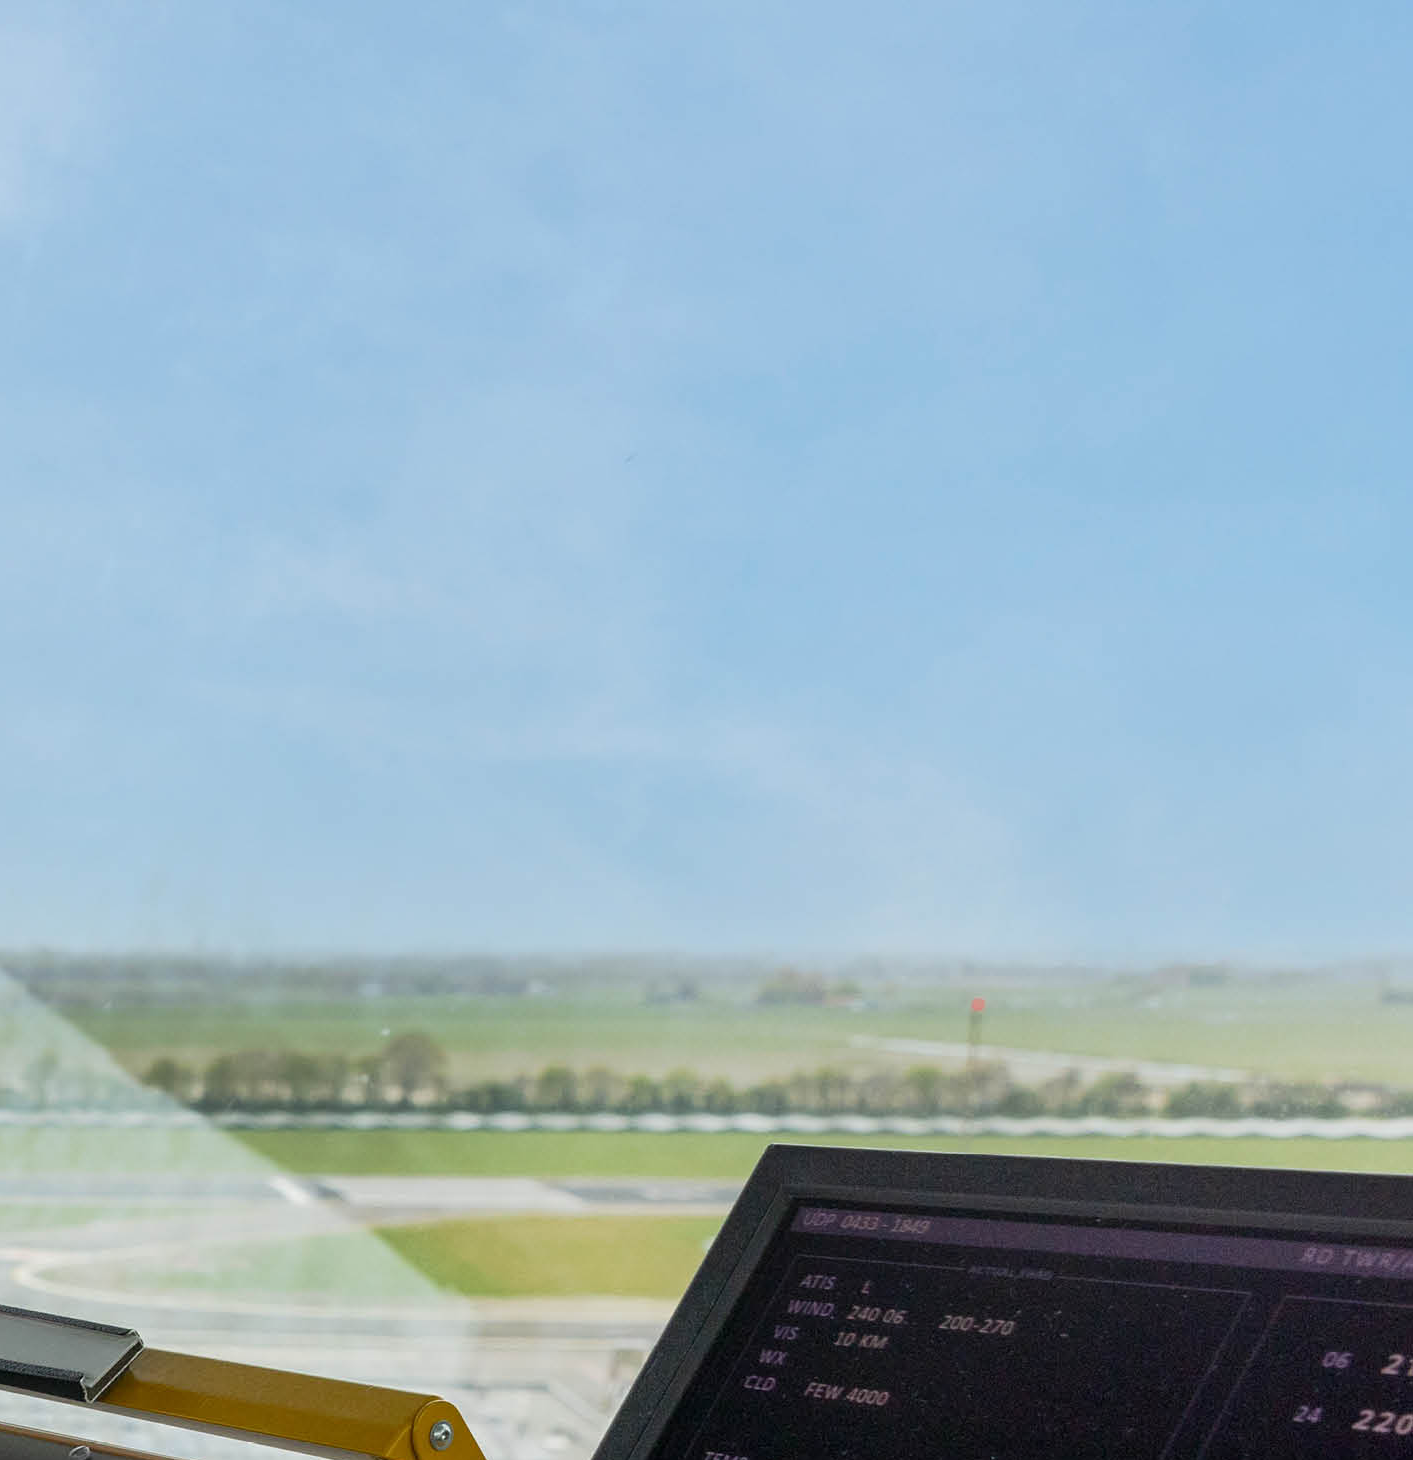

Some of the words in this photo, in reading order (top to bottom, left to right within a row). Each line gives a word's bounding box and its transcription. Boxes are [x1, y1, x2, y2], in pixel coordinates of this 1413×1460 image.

[799, 1274, 837, 1291] ATIS
[787, 1299, 835, 1317] WIND
[845, 1305, 881, 1322] 240
[881, 1308, 906, 1325] 06
[938, 1315, 1015, 1337] 200-270
[773, 1325, 800, 1341] VIS
[833, 1331, 855, 1347] 10
[858, 1334, 890, 1350] KM
[758, 1348, 789, 1366] WX
[1321, 1351, 1355, 1370] 06
[743, 1375, 776, 1392] CLD
[803, 1381, 842, 1400] FEW
[845, 1387, 890, 1407] 4000
[1293, 1405, 1324, 1424] 24
